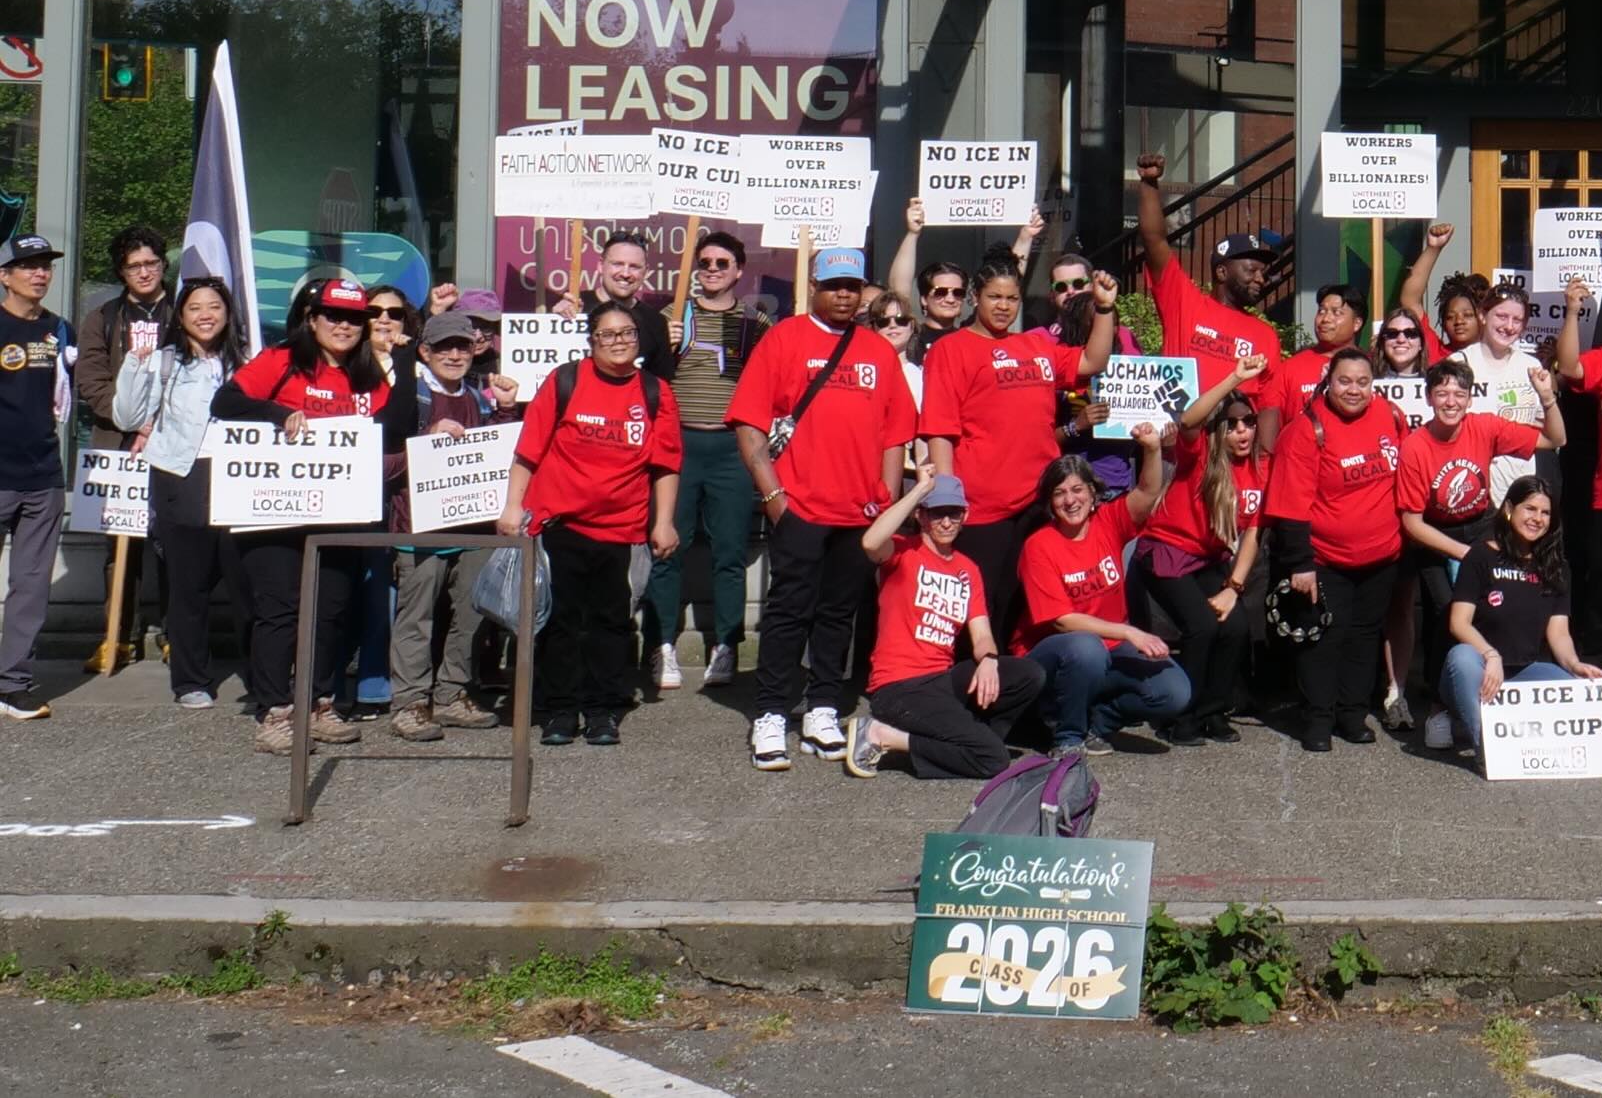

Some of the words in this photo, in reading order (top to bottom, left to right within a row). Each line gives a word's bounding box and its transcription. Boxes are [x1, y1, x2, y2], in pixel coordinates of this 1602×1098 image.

[525, 65, 849, 121] LEASING
[658, 133, 685, 149] NO
[696, 138, 729, 155] ICE
[769, 140, 843, 152] WORKERS
[1346, 137, 1412, 148] WORKERS
[927, 146, 956, 161] NO
[966, 147, 999, 161] ICE
[1008, 146, 1030, 161] IN
[1362, 155, 1397, 165] OVER
[501, 155, 536, 173] FAITH
[538, 153, 586, 173] ACTION
[588, 154, 652, 173] NETWORK
[786, 159, 825, 170] OVER
[747, 177, 861, 190] BILLIONAIRES!
[929, 175, 971, 189] OUR
[980, 175, 1026, 189] CUP!
[1329, 173, 1429, 184] BILLIONAIRES!
[508, 319, 539, 334] NO
[551, 319, 588, 334] ICE
[1096, 383, 1123, 394] POR
[1127, 384, 1150, 394] LOS
[82, 454, 110, 469] NO
[119, 457, 148, 472] ICE
[447, 453, 485, 467] OVER
[227, 462, 280, 479] OUR
[291, 462, 352, 480] CUP!
[416, 469, 509, 493] BILLIONAIRE
[920, 569, 969, 600] UNITE
[918, 589, 966, 620] HERE!
[1487, 688, 1521, 706] NO
[1532, 687, 1574, 704] ICE
[1494, 721, 1544, 738] OUR
[951, 852, 1126, 897] Congratulations
[935, 903, 1018, 919] FRANKLIN
[1023, 906, 1062, 920] HIGH
[1067, 909, 1130, 923] SCHOOL
[941, 922, 1115, 1010] 2026
[1069, 981, 1091, 998] OF
